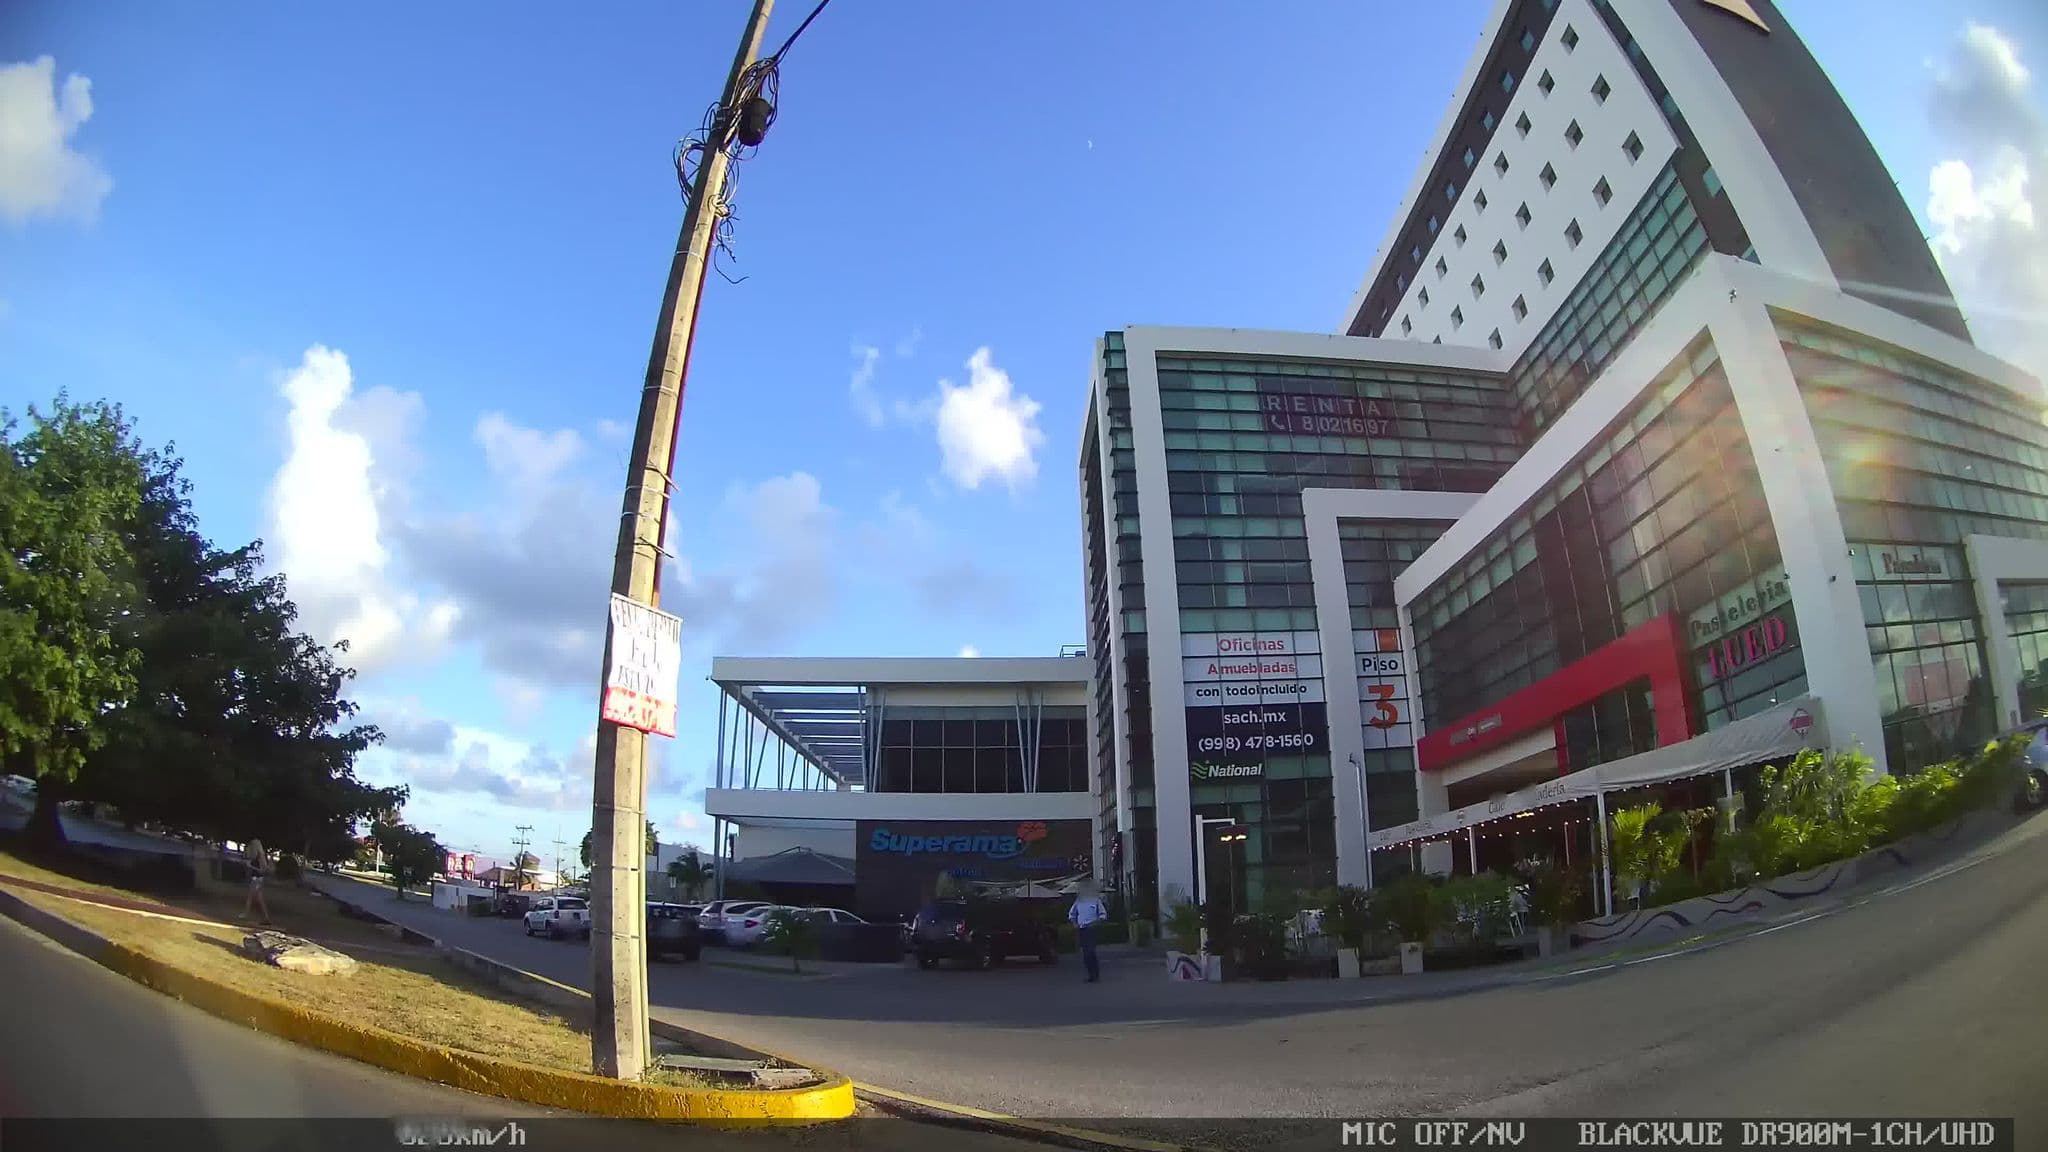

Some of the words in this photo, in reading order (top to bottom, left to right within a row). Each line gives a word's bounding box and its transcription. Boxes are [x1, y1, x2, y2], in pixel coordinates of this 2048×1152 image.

[1267, 394, 1381, 416] RENTA
[1219, 638, 1285, 652] Oficinas
[1207, 661, 1297, 675] Amuebladas
[1362, 657, 1399, 671] Piso
[1196, 688, 1219, 697] con
[1367, 684, 1399, 730] 3
[1224, 710, 1287, 724] sach.mx
[1198, 736, 1241, 752] (998)
[1245, 733, 1314, 749] 478-1560
[1208, 763, 1263, 777] National
[870, 827, 1018, 856] Superama
